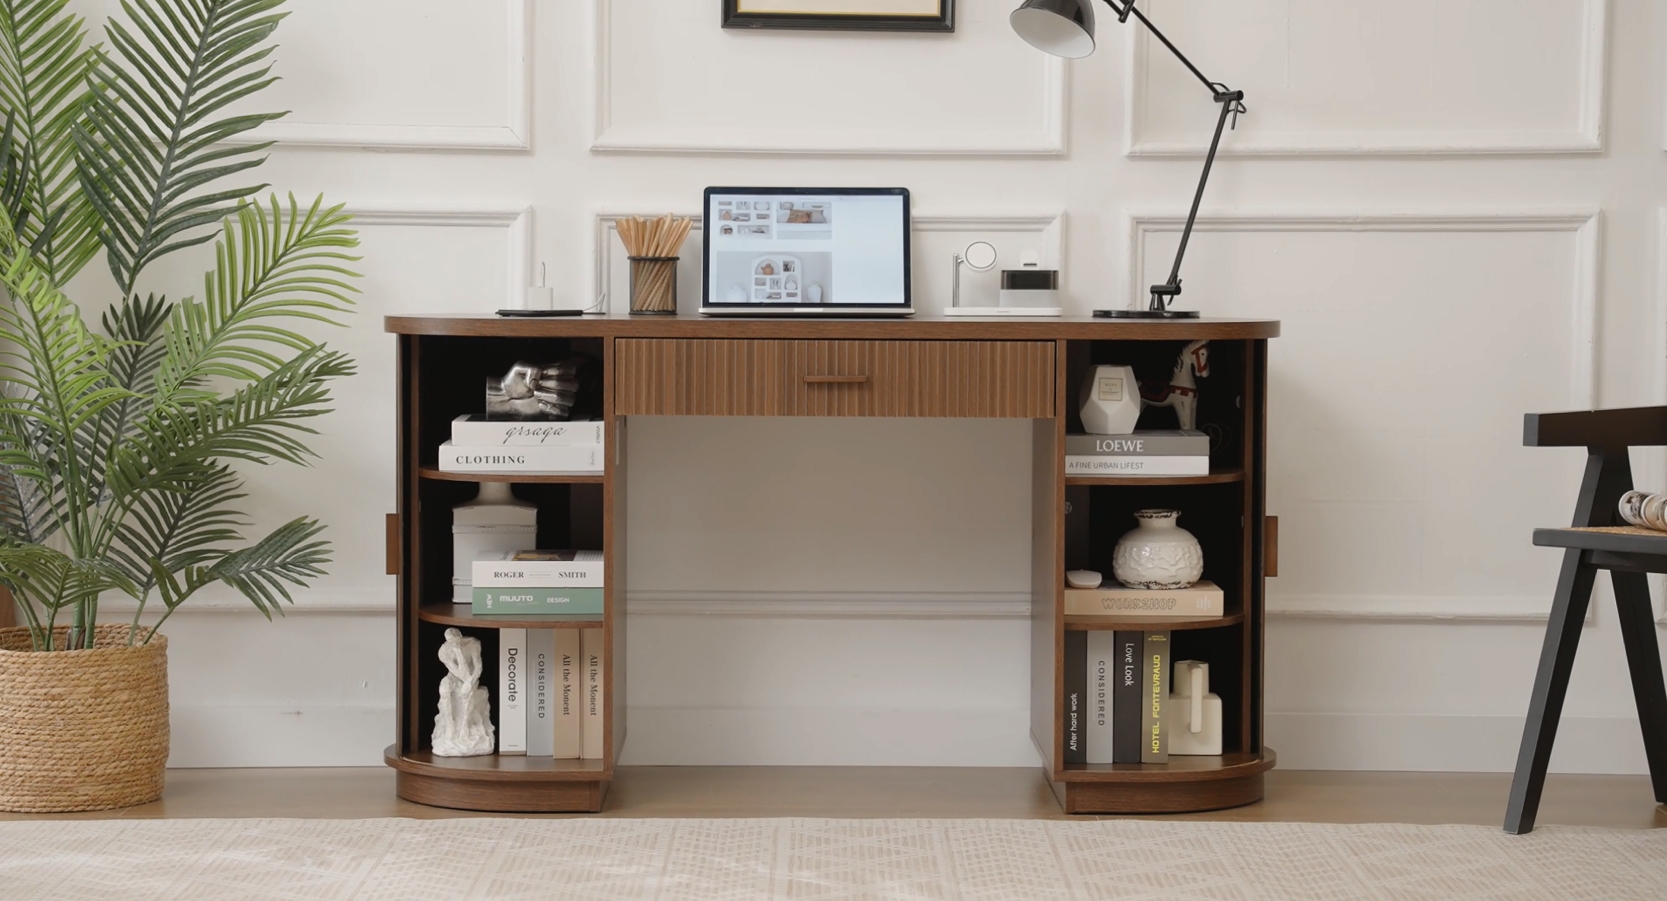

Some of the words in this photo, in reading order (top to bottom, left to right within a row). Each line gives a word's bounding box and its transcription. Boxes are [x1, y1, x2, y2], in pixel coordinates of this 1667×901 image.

[1096, 440, 1144, 452] LOEWE
[455, 455, 526, 465] CLOTHING
[1120, 462, 1144, 470] LIFEST
[493, 571, 525, 579] ROGER
[558, 571, 587, 579] SMITH
[1101, 598, 1177, 610] WORKSHOP
[1125, 643, 1134, 663] Love
[563, 654, 571, 667] All
[590, 654, 598, 667] All
[508, 648, 518, 702] Decorate
[563, 668, 571, 683] the
[590, 668, 598, 683] the
[1124, 666, 1134, 686] Look
[1152, 654, 1161, 718] FONTEVRAUD
[1152, 721, 1160, 754] HOTEL
